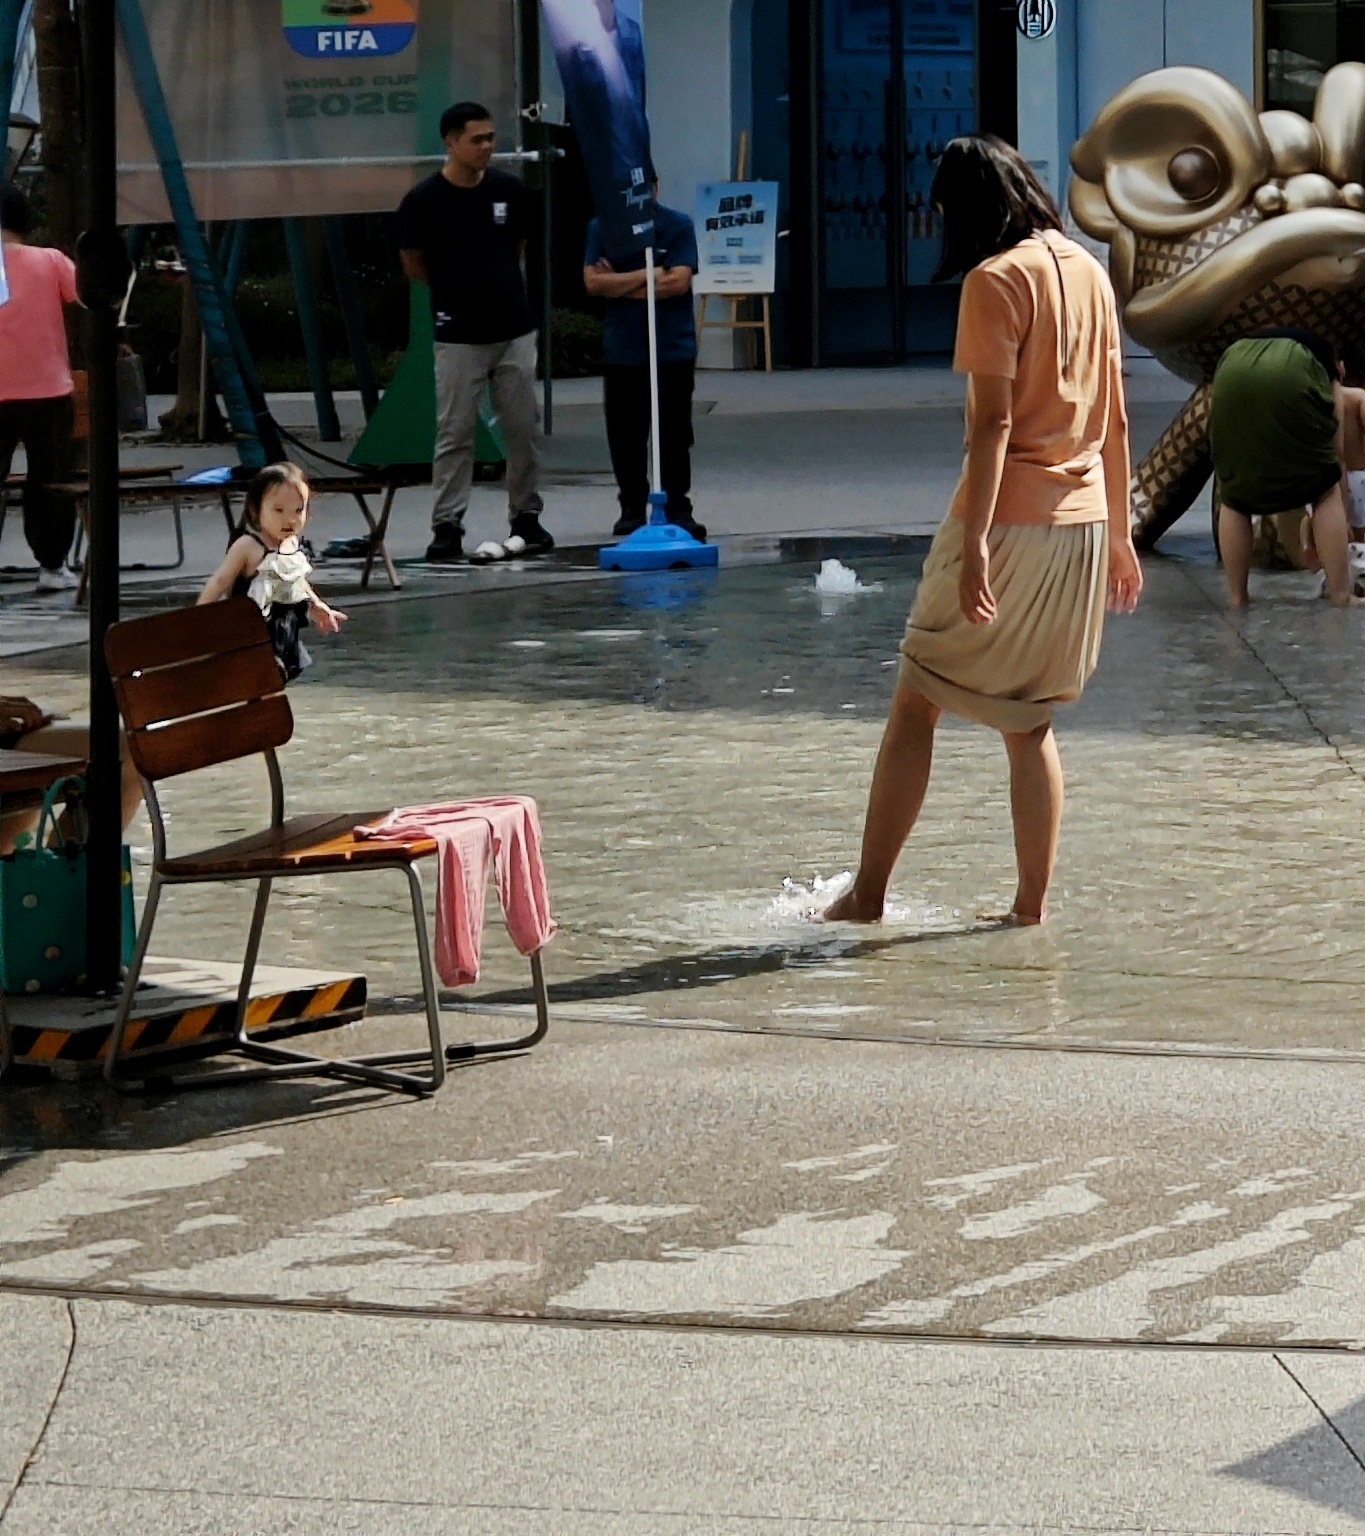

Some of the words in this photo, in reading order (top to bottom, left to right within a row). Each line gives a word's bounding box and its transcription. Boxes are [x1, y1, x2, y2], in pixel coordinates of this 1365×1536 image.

[317, 30, 378, 51] FIFA
[372, 74, 418, 86] CUP
[286, 91, 418, 118] 2026
